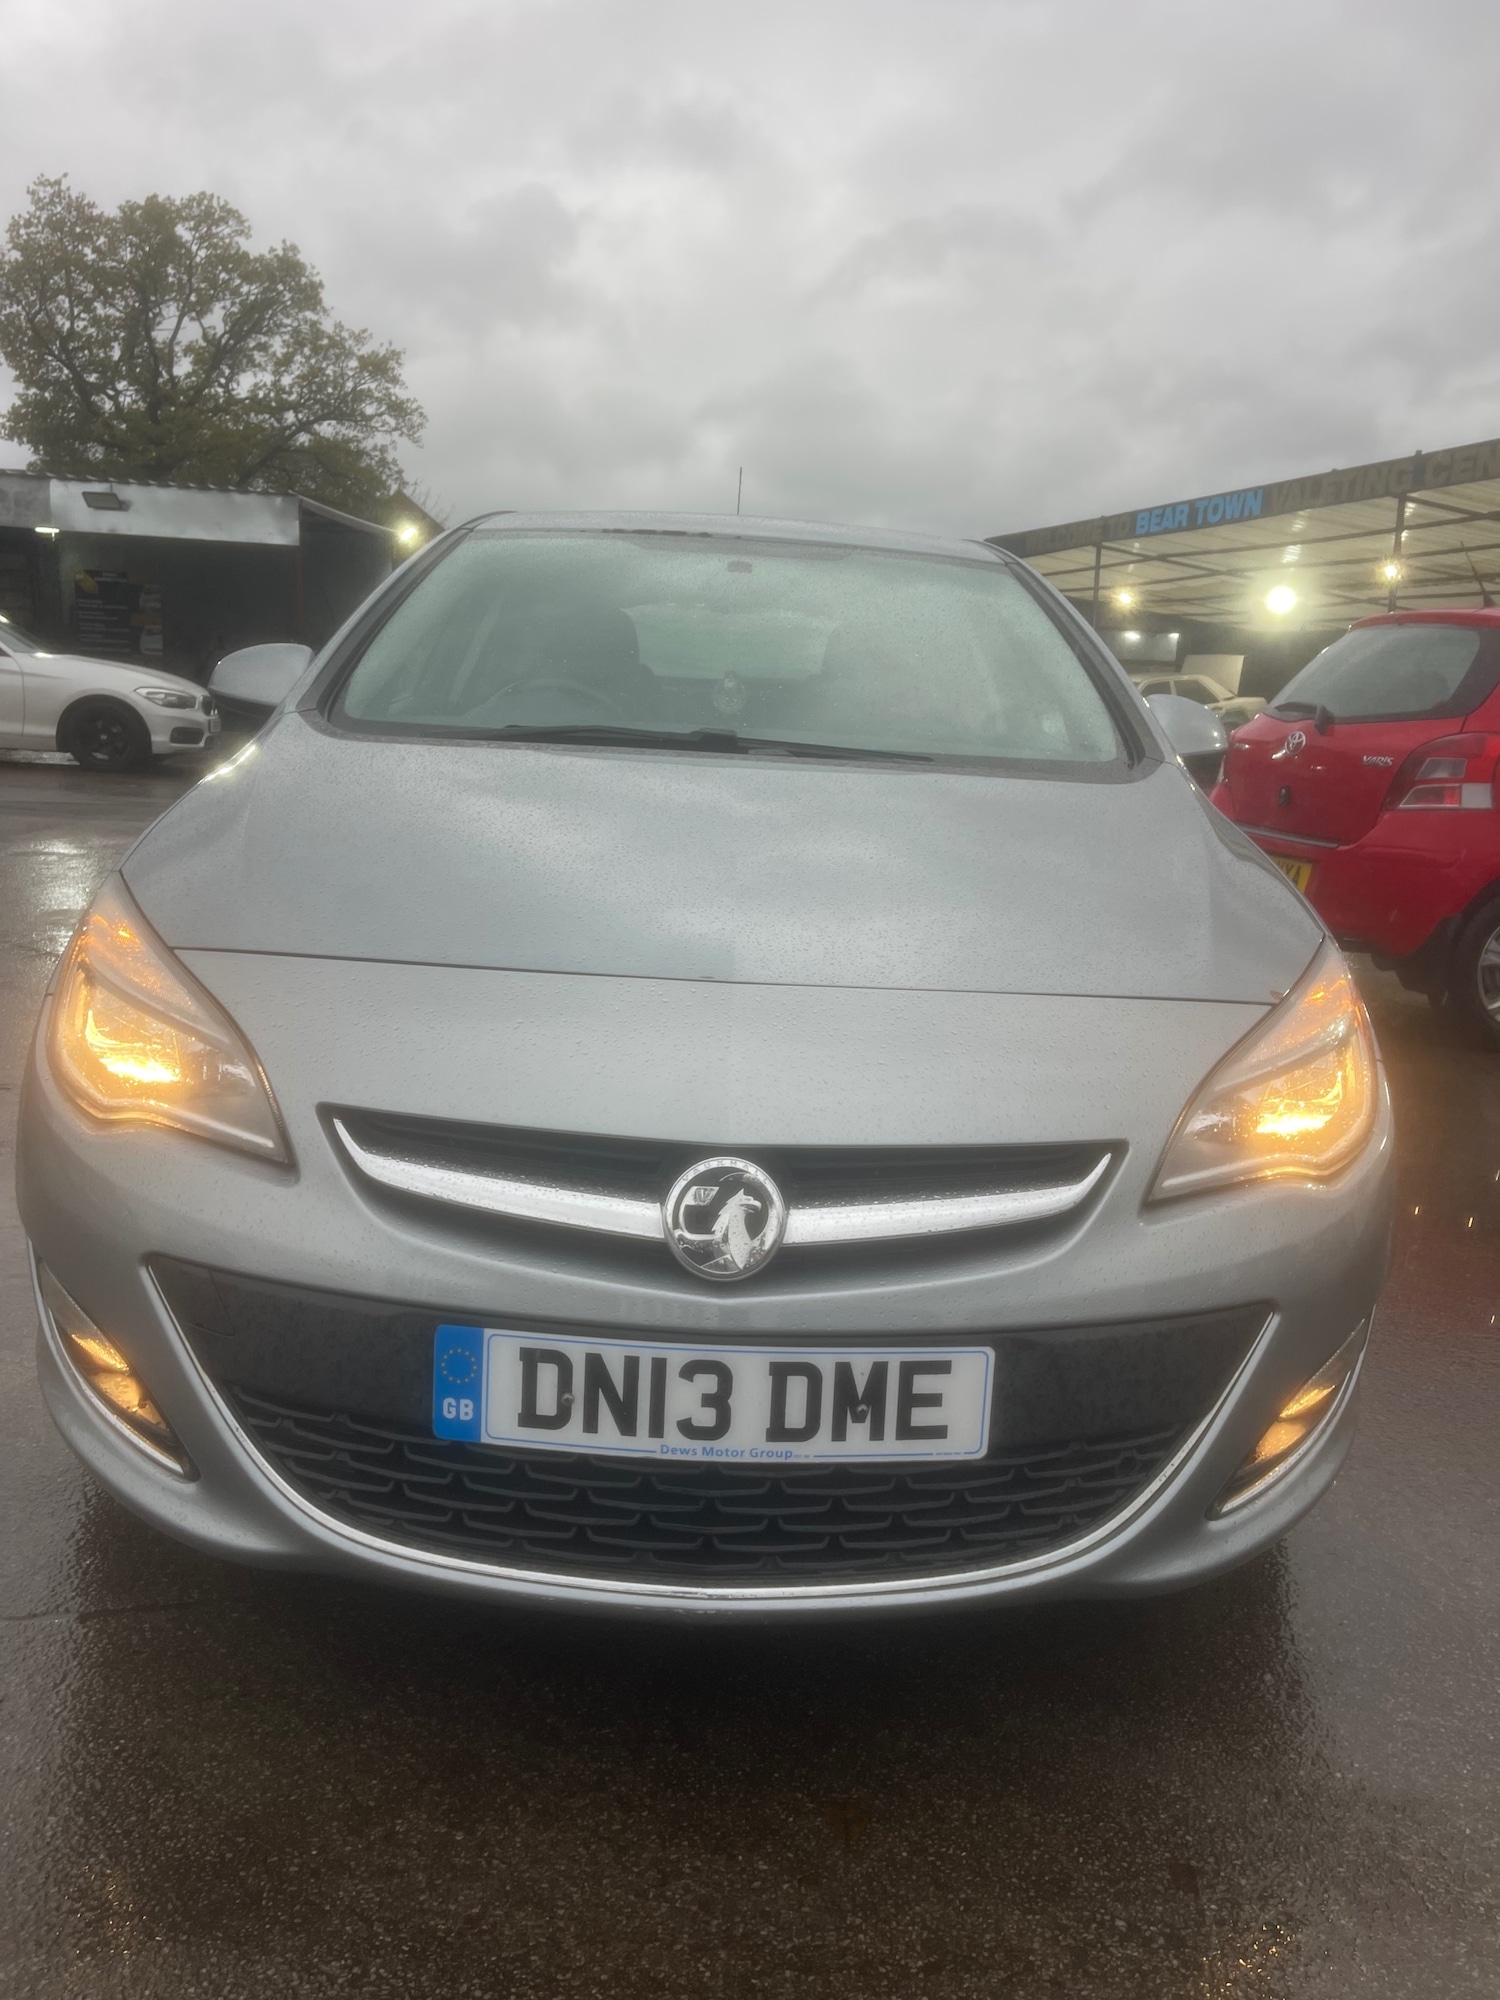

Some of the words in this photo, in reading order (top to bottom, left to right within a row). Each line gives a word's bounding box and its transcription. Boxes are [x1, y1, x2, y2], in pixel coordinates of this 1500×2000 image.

[1026, 519, 1101, 553] WELCOME
[1107, 513, 1131, 538] TO
[1136, 503, 1189, 535] BEAR
[1195, 488, 1263, 526] TOWN
[1272, 460, 1413, 510] VALETING
[1363, 755, 1394, 767] YARIS
[681, 1158, 769, 1185] VAUXHALL
[518, 1346, 733, 1441] DN13
[765, 1360, 952, 1441] DME
[442, 1397, 474, 1421] GB
[660, 1444, 698, 1456] Dews
[701, 1446, 745, 1458] Motor
[749, 1448, 793, 1460] Group
